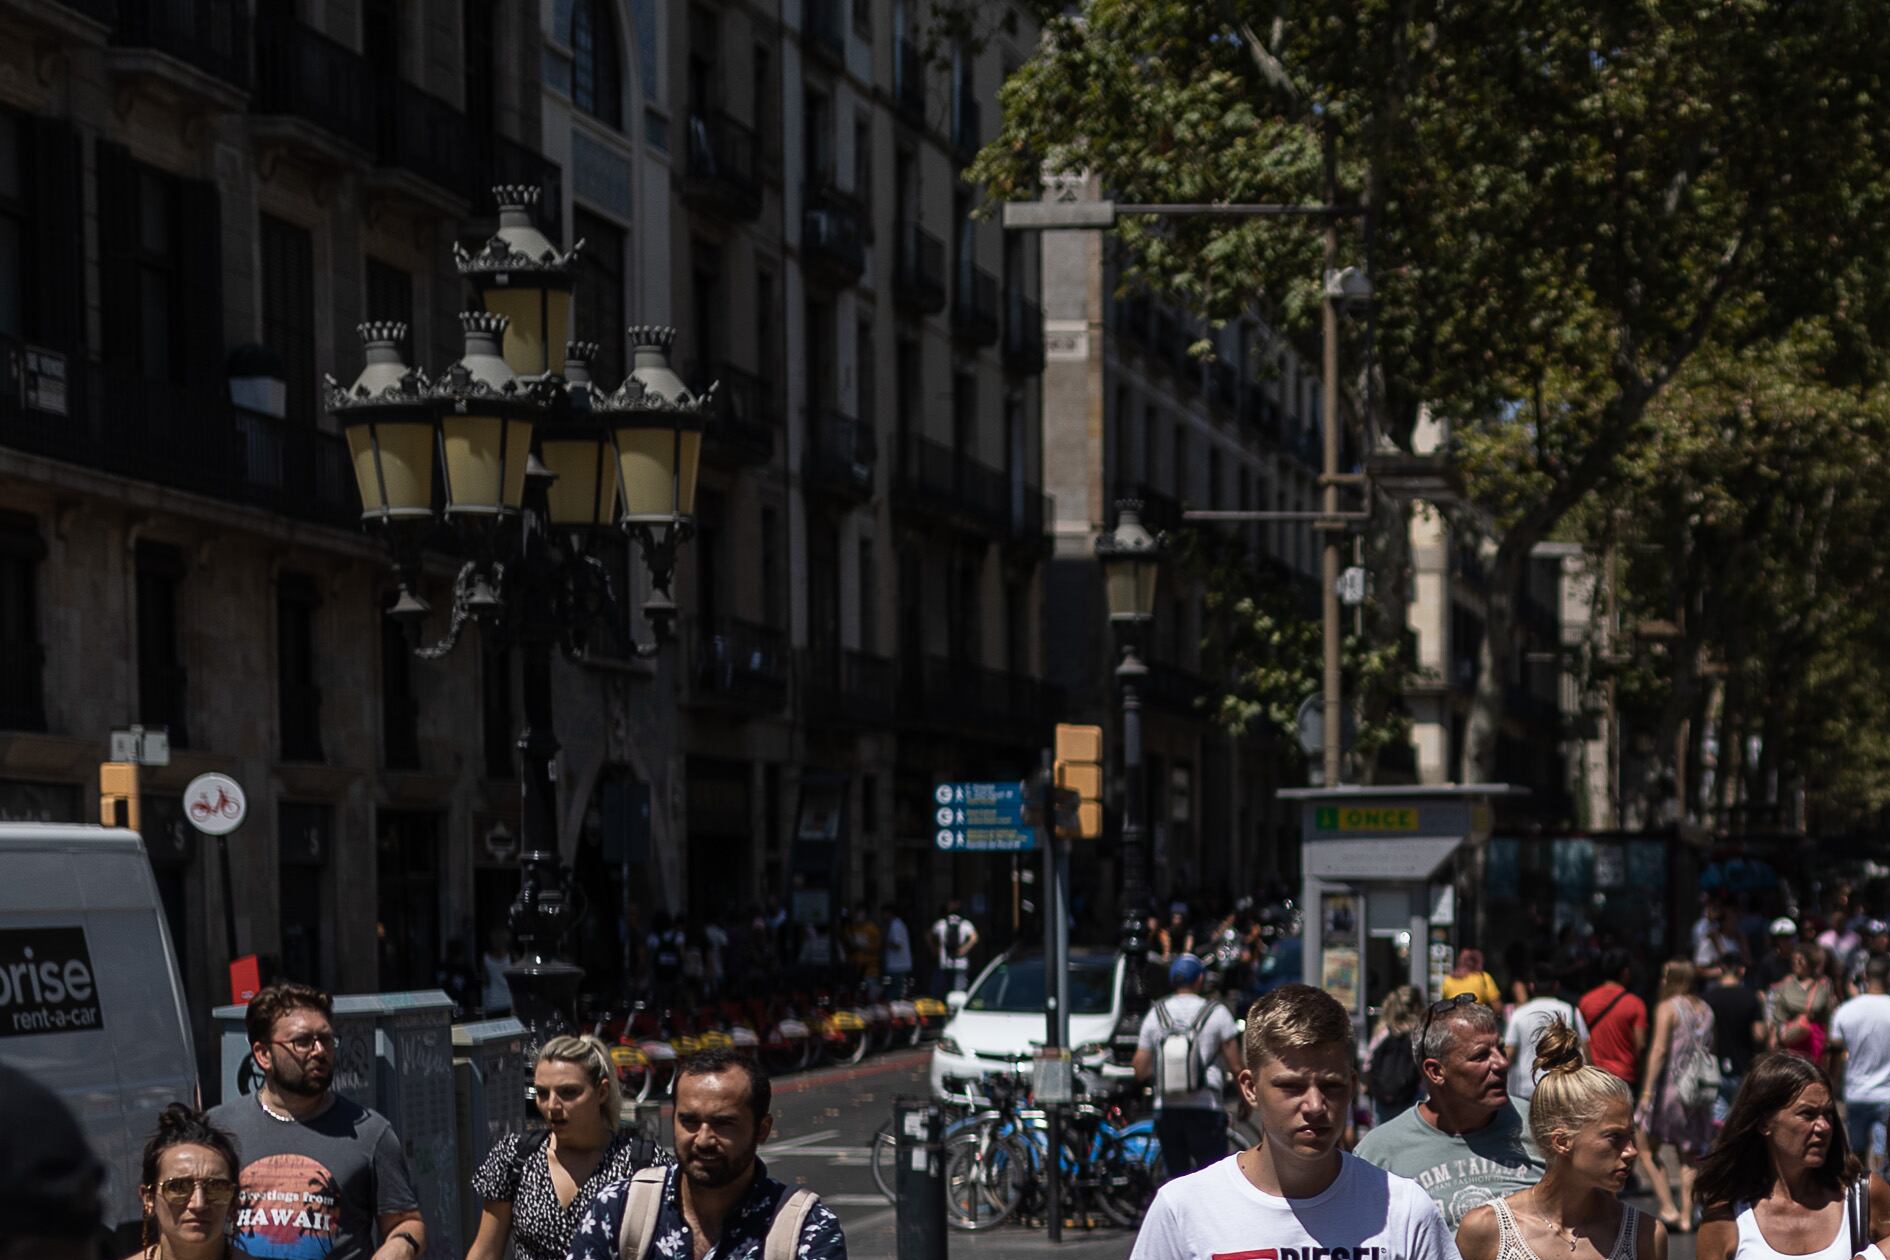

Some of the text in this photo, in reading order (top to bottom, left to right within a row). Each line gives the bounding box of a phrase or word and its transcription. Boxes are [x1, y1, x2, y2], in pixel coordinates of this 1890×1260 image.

[1346, 808, 1411, 828] ONCE
[12, 1006, 97, 1031] rent-a-car
[1420, 1162, 1452, 1190] OM
[303, 1191, 335, 1206] from
[237, 1208, 332, 1232] HAWAII
